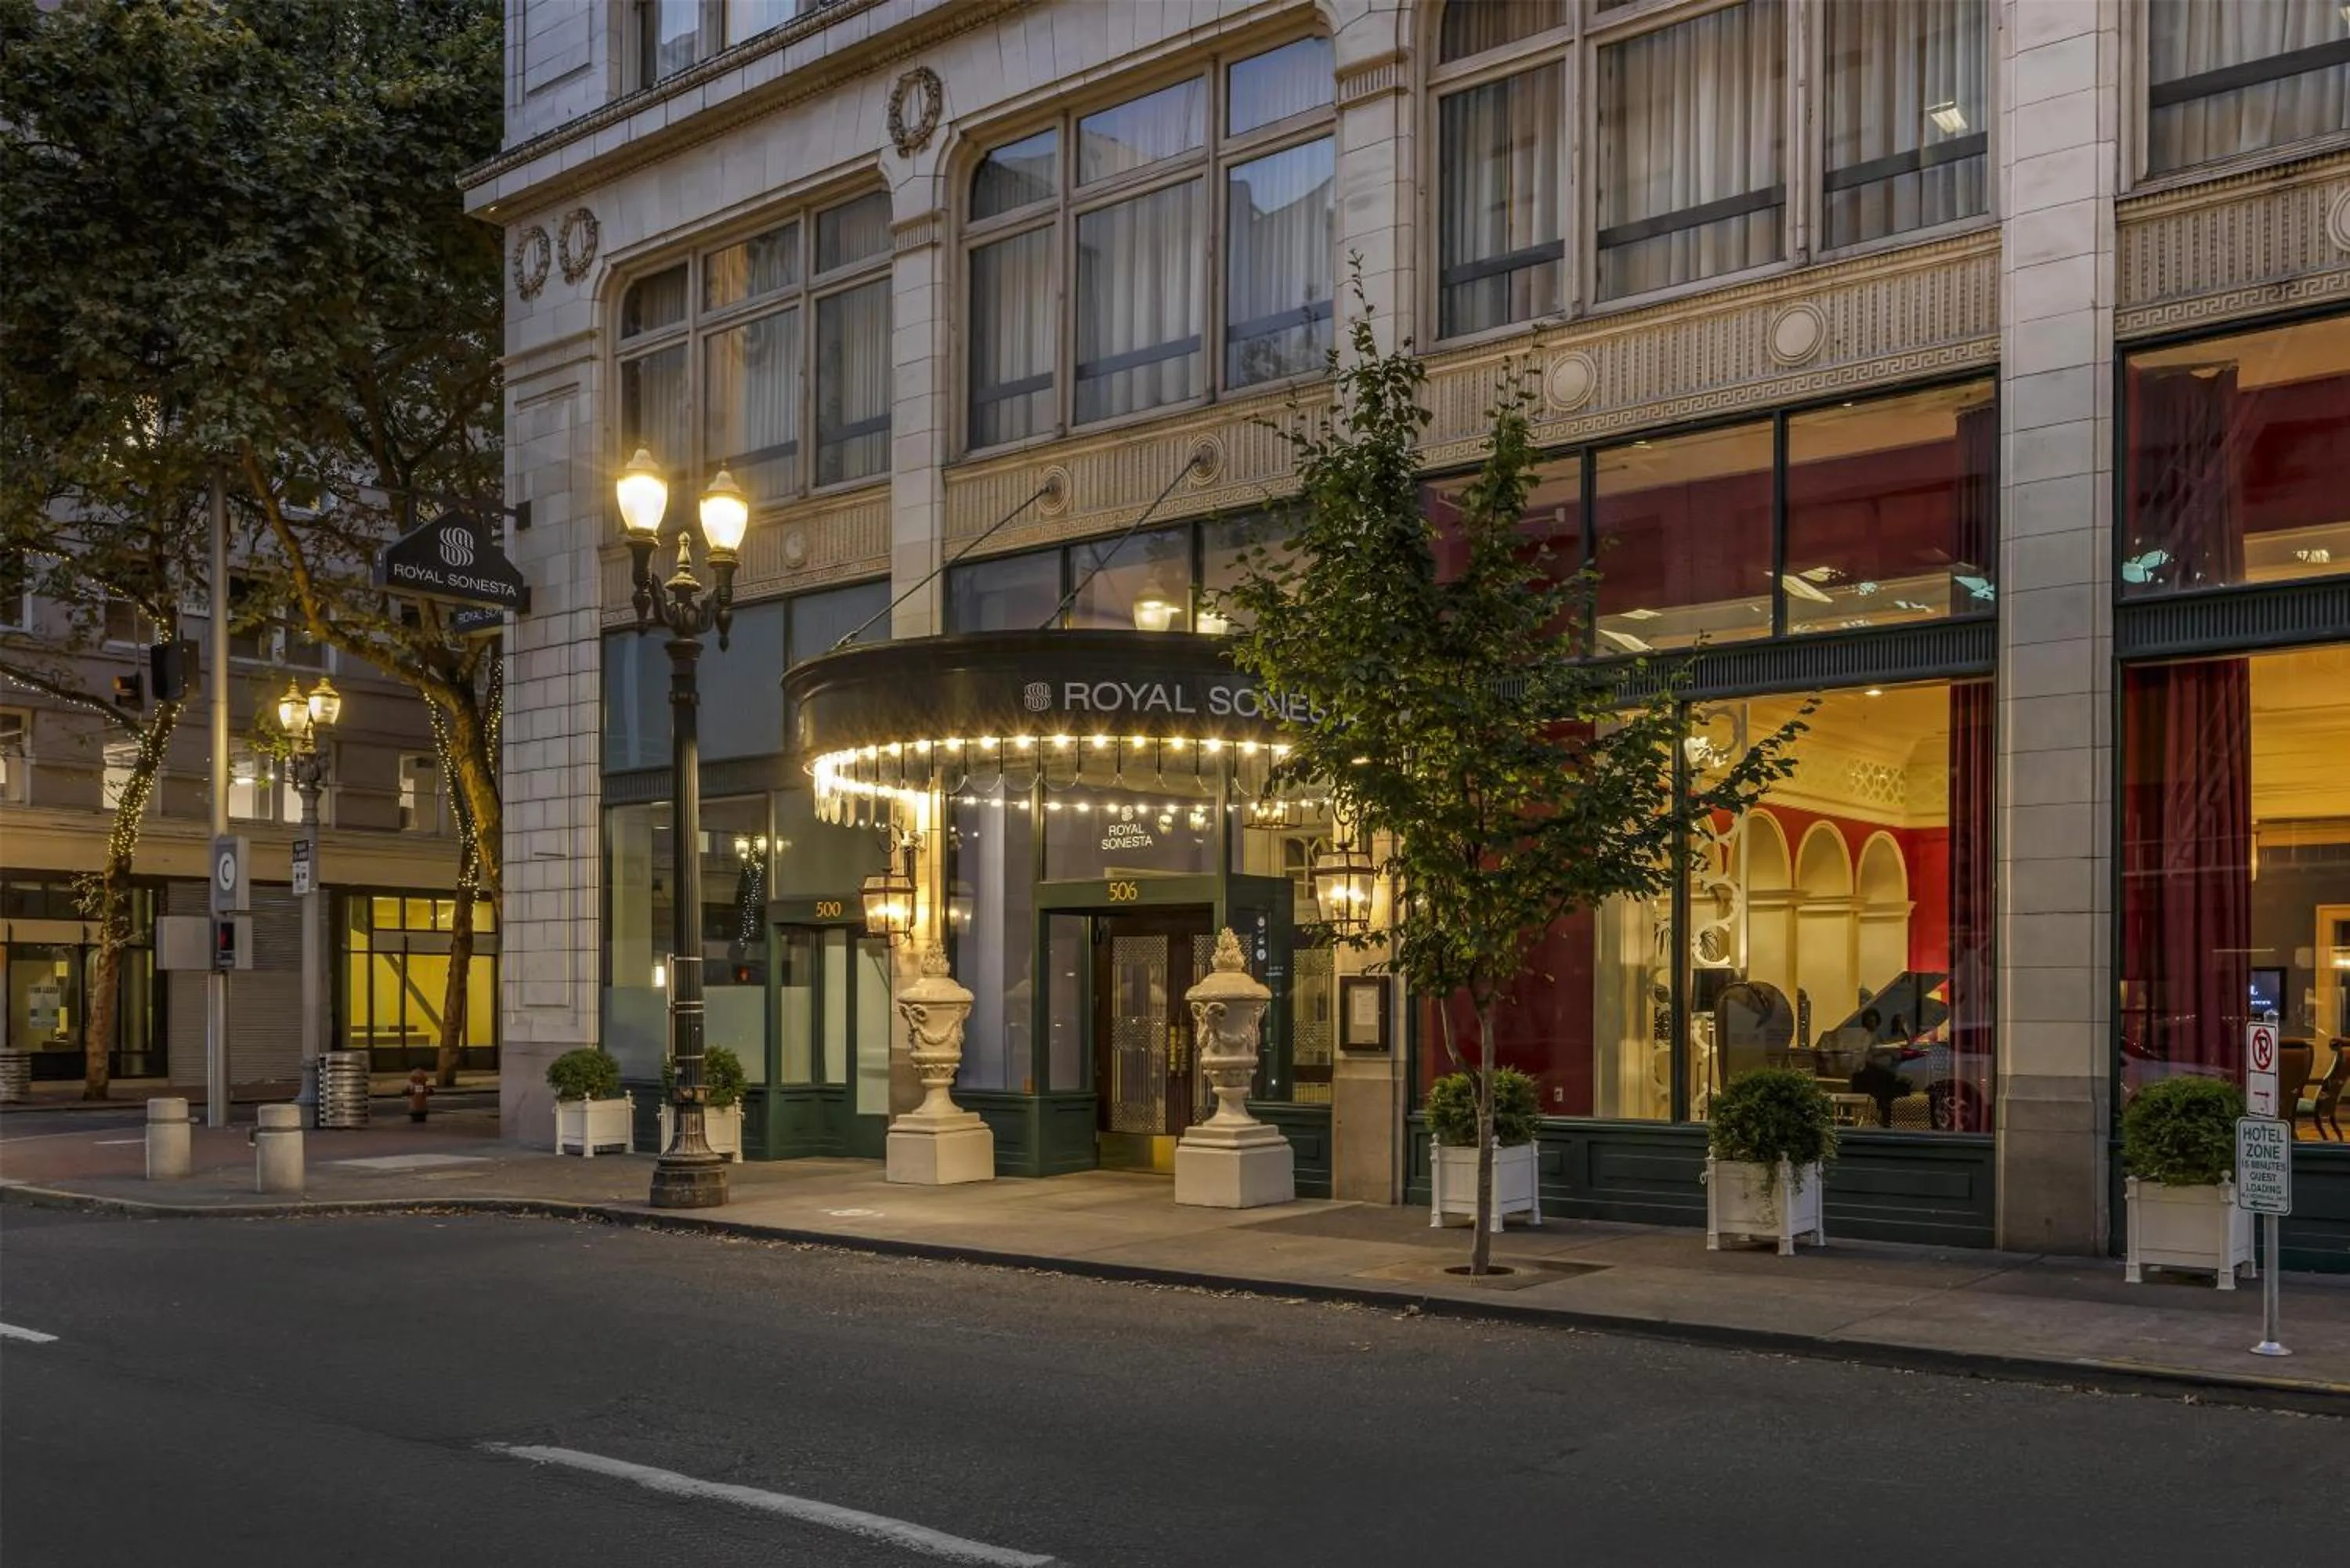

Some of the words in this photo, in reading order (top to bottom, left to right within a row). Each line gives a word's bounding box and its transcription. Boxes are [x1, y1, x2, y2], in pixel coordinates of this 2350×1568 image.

[394, 563, 444, 583] ROYAL
[447, 573, 517, 597] SONESTA
[1064, 681, 1197, 714] ROYAL
[1209, 685, 1346, 725] SONES
[1108, 823, 1144, 836] ROYAL
[1101, 836, 1154, 850] SONESTA
[1109, 882, 1137, 901] 506
[816, 901, 841, 917] 500
[2243, 1126, 2285, 1143] HOTEL
[2246, 1143, 2281, 1159] ZONE
[2245, 1183, 2282, 1194] LOADING
